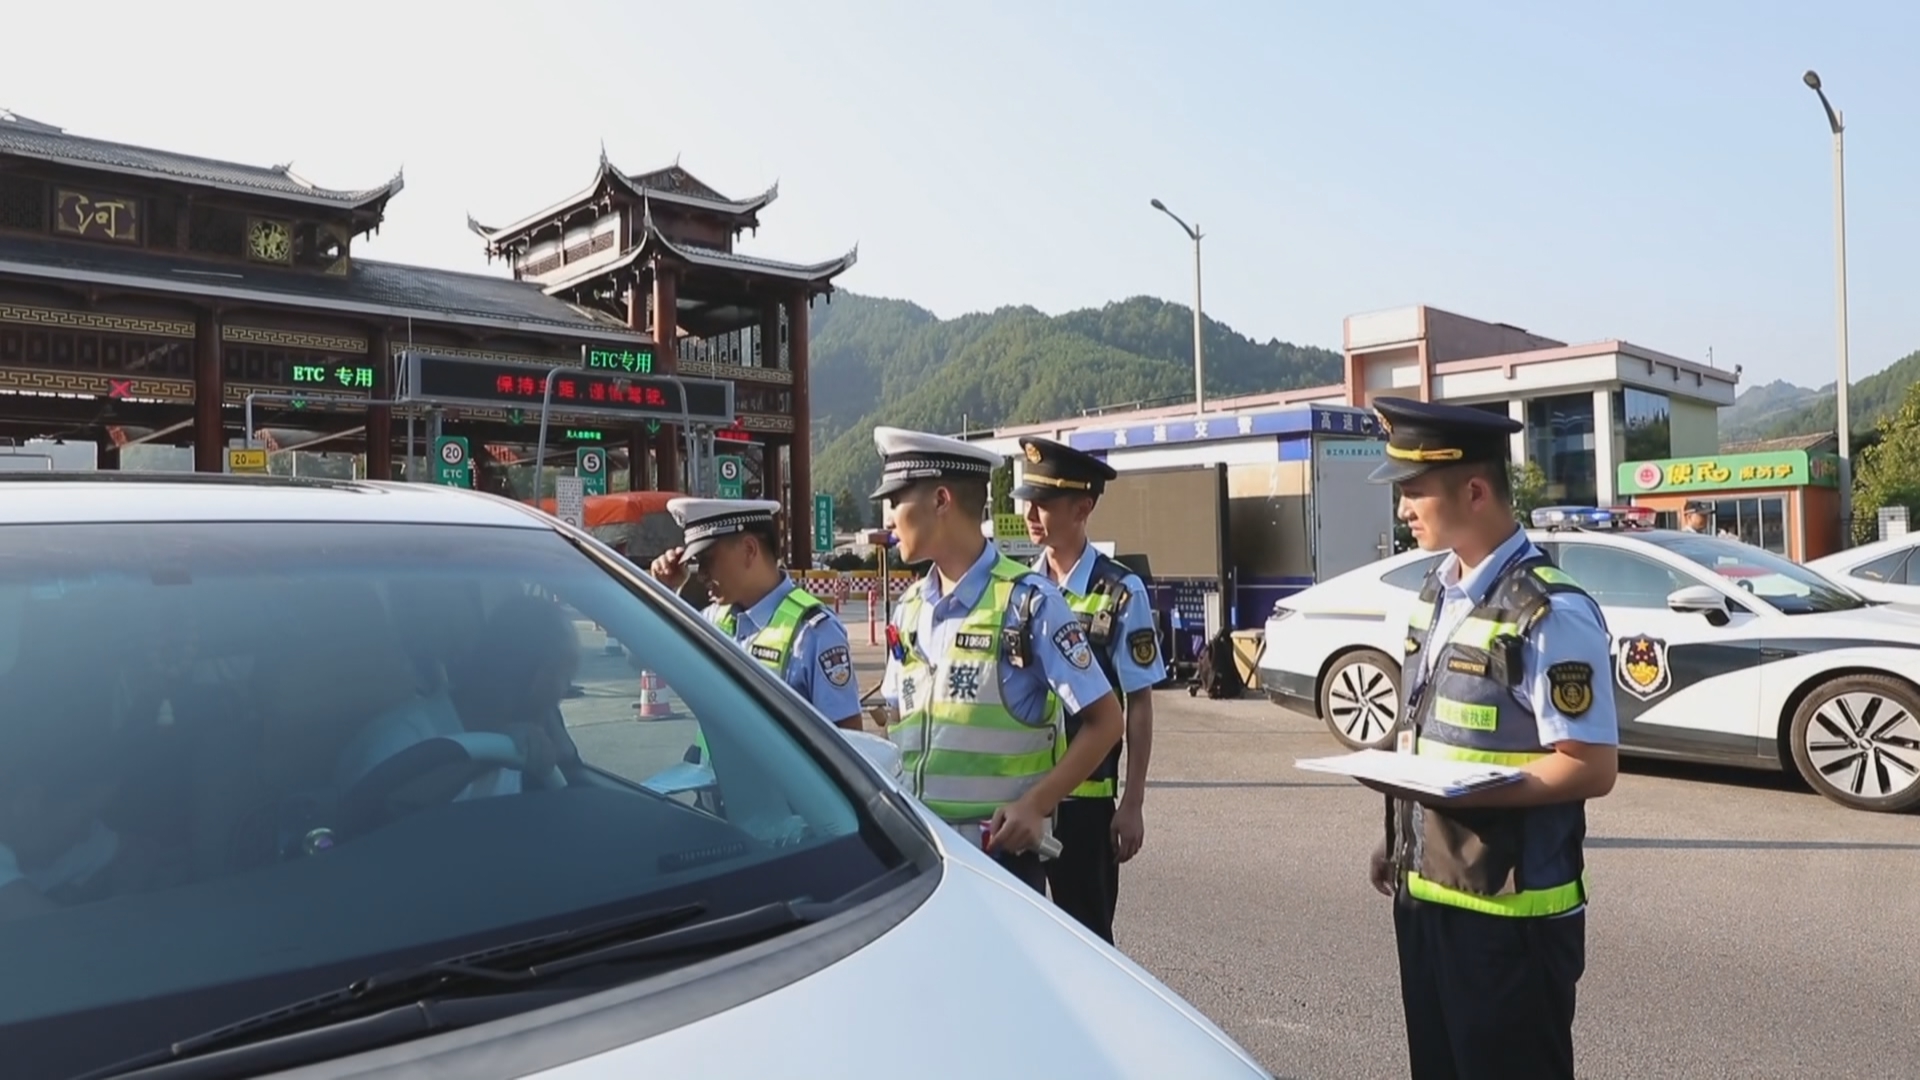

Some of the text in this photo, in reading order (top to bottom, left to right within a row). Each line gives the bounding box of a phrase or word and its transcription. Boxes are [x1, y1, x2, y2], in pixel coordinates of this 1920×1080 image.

[75, 194, 125, 239] 河
[590, 350, 652, 374] ETC专用
[293, 366, 373, 387] ETC 专用
[1114, 415, 1253, 447] 高速交警
[234, 453, 247, 465] 20
[442, 446, 461, 460] 20
[443, 469, 463, 479] ETC
[587, 456, 600, 474] 5
[724, 463, 734, 480] 5
